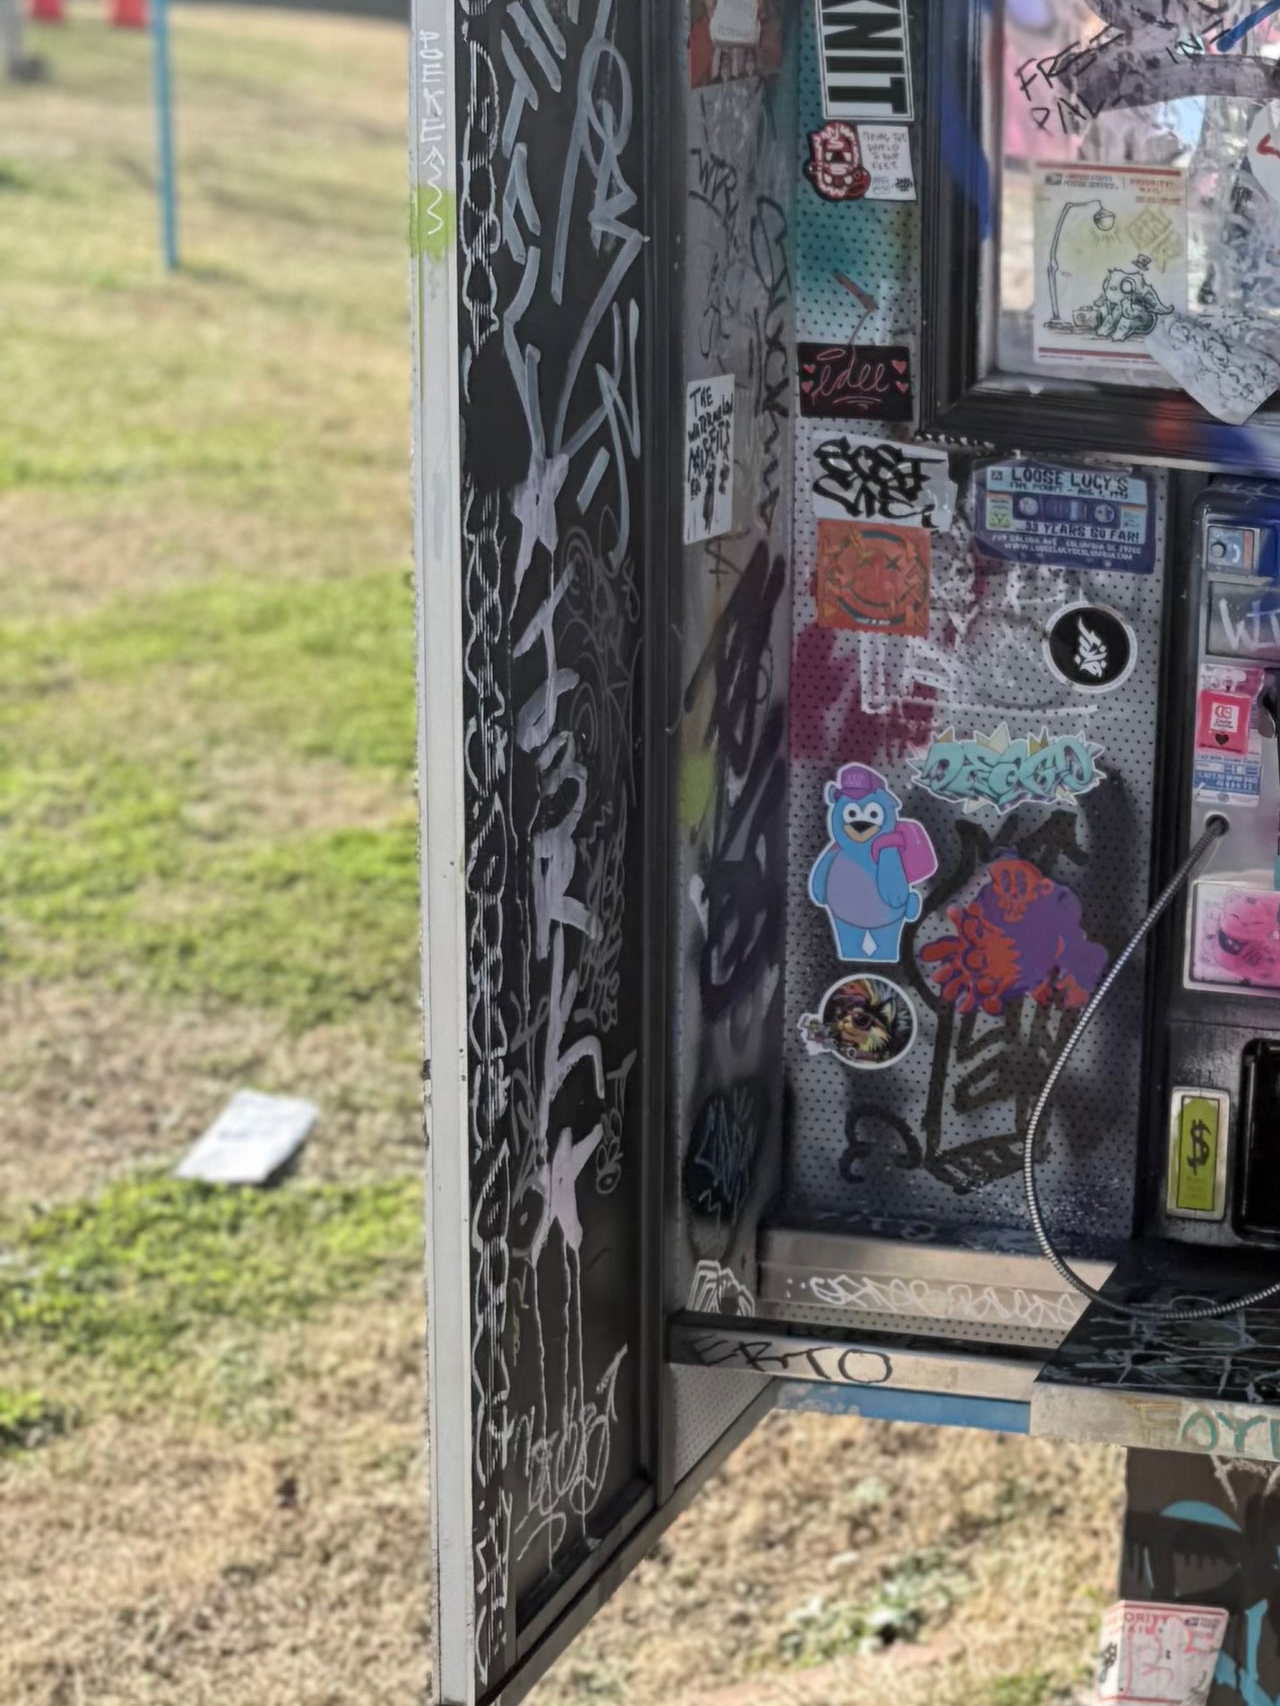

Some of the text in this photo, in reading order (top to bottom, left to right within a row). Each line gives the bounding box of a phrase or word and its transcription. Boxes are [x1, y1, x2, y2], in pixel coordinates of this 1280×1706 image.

[690, 385, 713, 418] THE
[1011, 467, 1128, 493] LOOSE LUCY'S
[1045, 523, 1085, 537] YEARS
